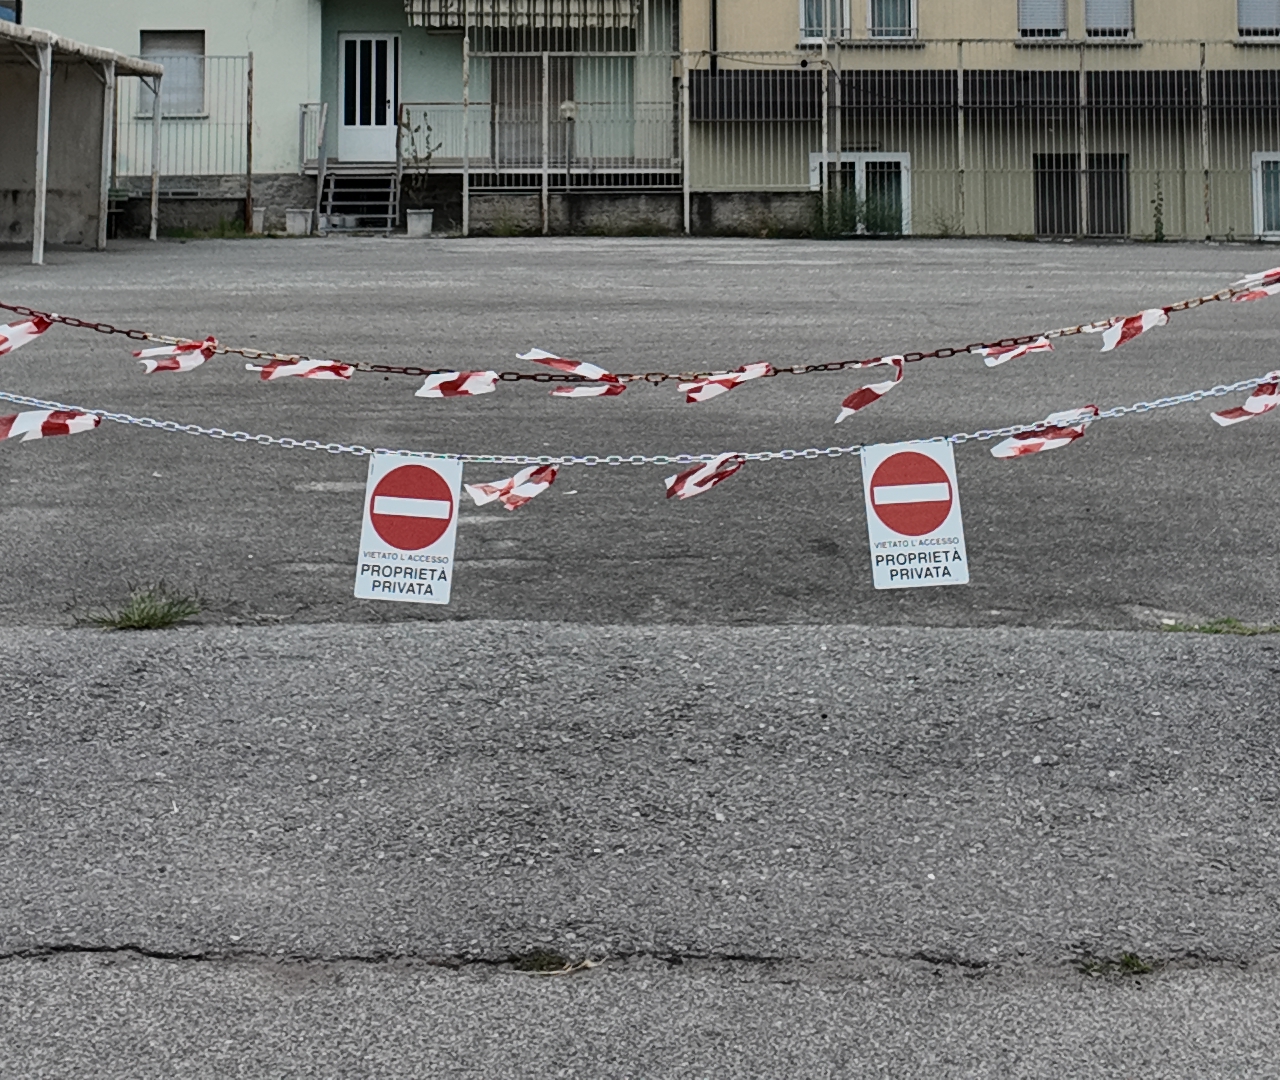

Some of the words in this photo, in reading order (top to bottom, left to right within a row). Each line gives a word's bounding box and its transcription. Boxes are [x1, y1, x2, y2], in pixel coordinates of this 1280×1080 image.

[874, 539, 909, 549] VIETATO
[911, 536, 960, 547] L'ACCESSO
[363, 550, 398, 561] VIETATO
[400, 553, 450, 564] L'ACCESSO
[875, 547, 962, 567] PROPRIETÀ
[360, 563, 448, 582] PROPRIETÀ
[889, 565, 952, 581] PRIVATA
[371, 579, 434, 596] PRIVATA
